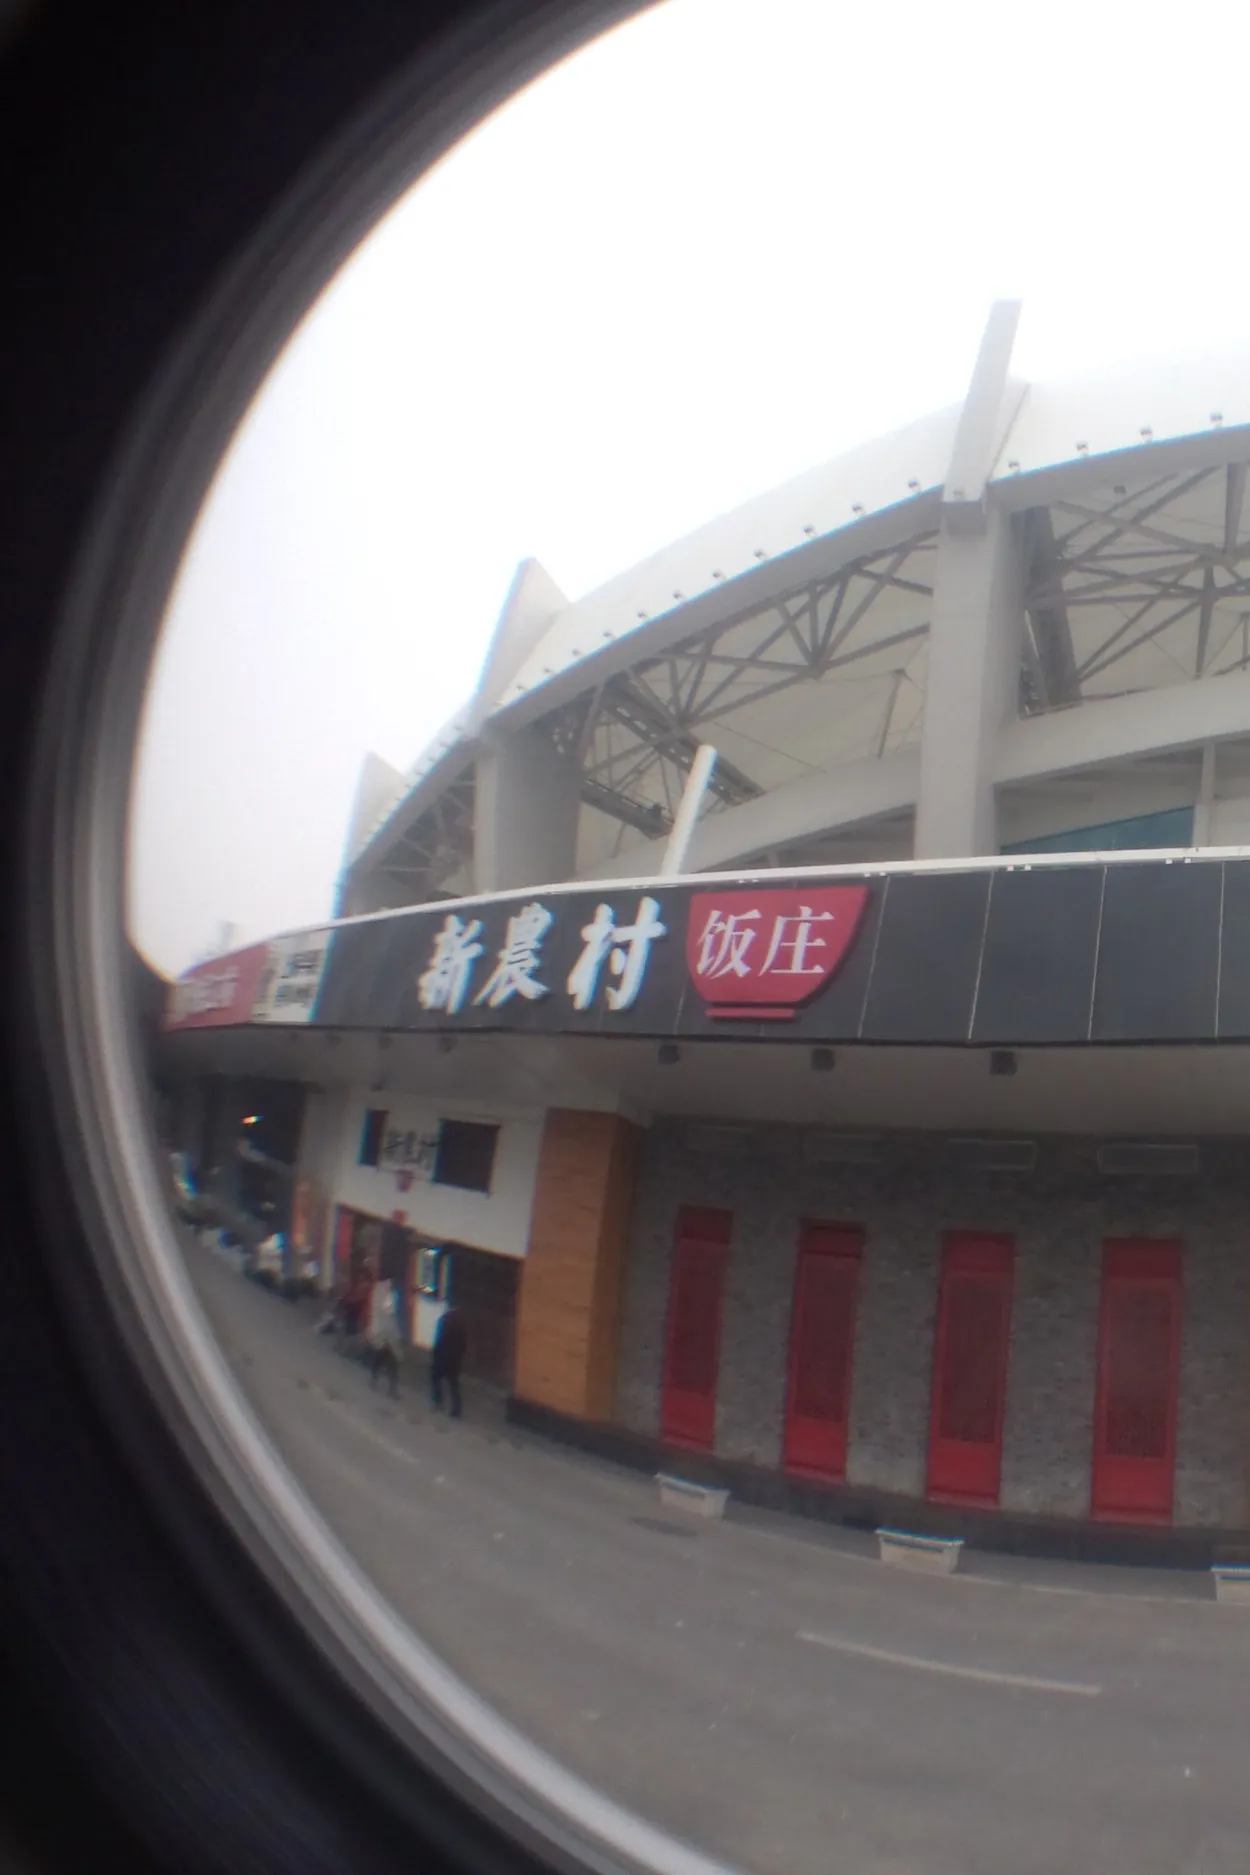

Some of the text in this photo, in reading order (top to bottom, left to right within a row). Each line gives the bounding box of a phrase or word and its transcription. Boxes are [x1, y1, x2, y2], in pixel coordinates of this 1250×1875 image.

[419, 897, 667, 1014] 新農村
[696, 905, 836, 979] 饭庄
